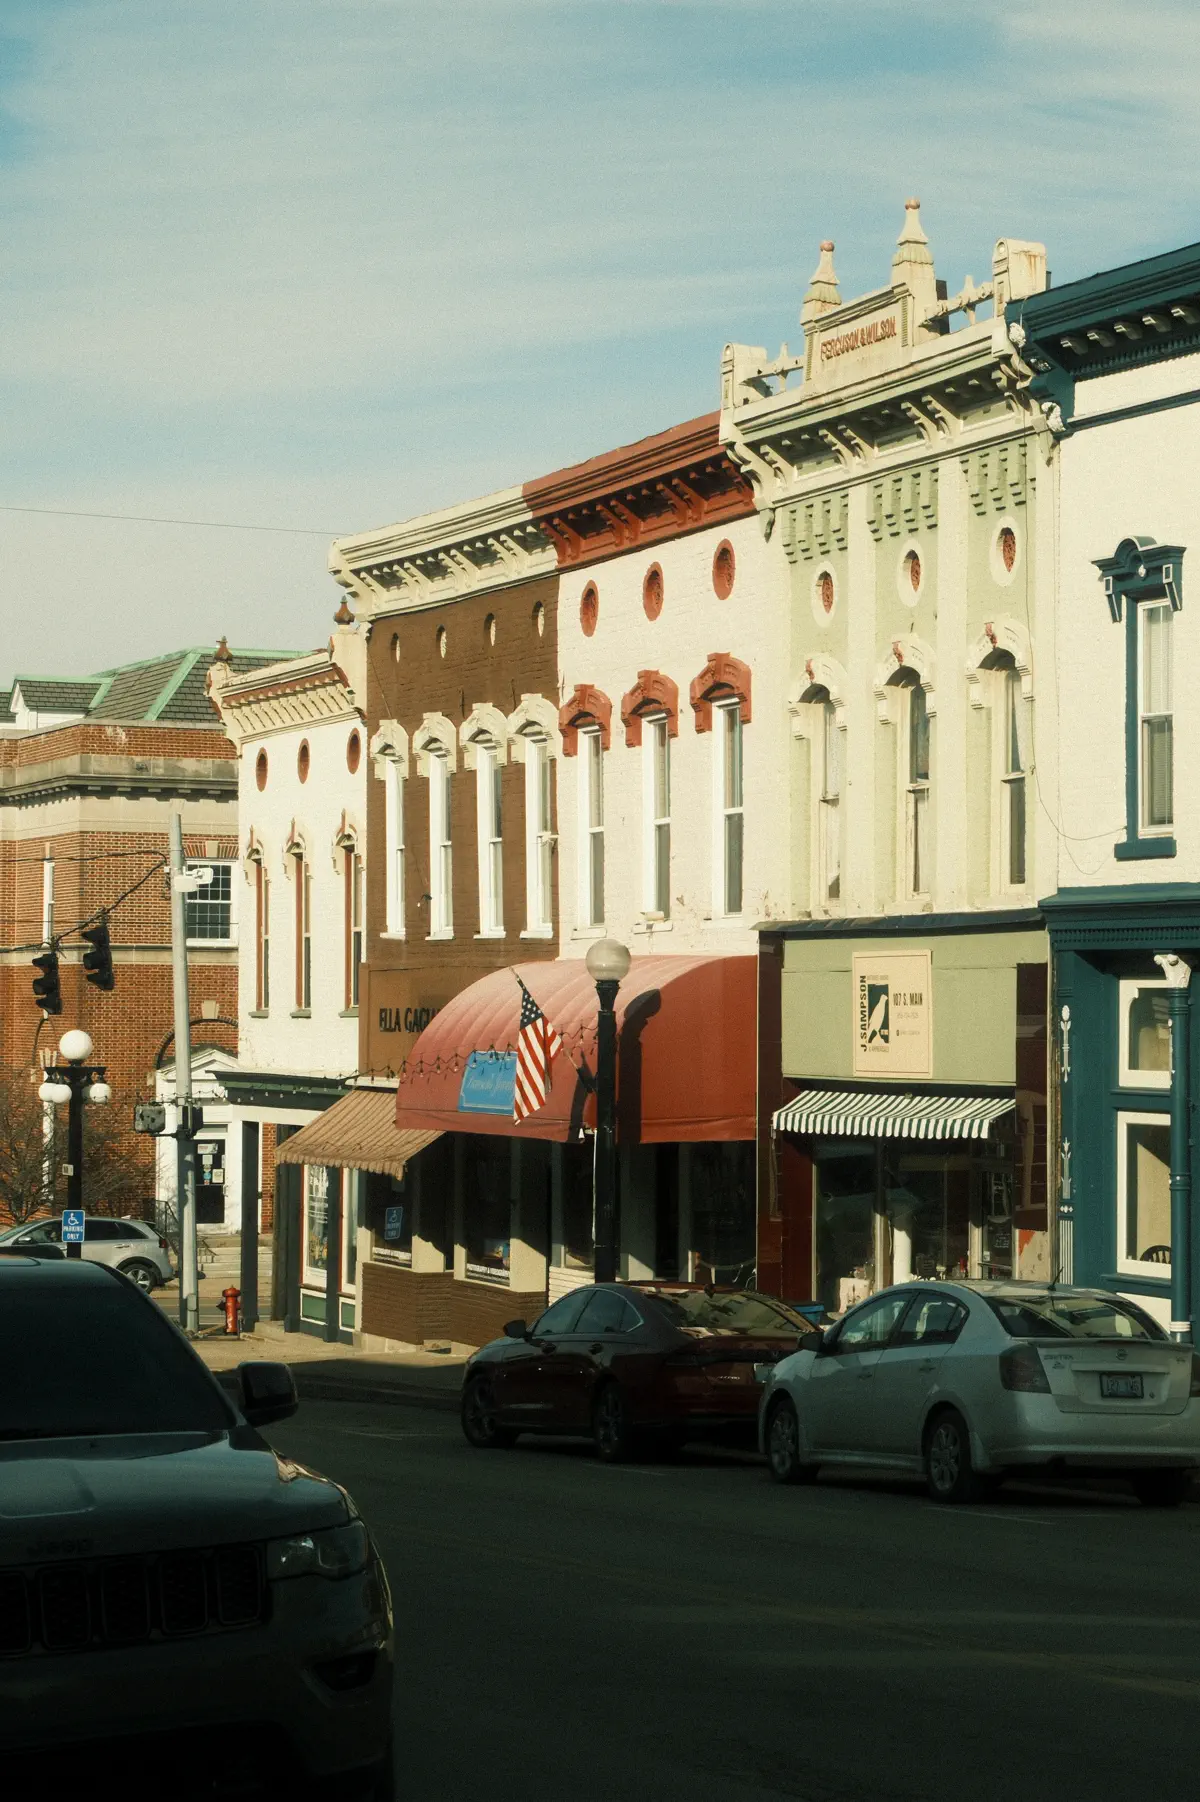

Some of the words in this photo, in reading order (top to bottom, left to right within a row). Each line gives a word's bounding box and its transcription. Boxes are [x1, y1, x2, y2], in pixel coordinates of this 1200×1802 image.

[820, 328, 860, 362] FERGUSON
[860, 327, 866, 347] &
[866, 316, 897, 346] WILSON
[893, 993, 902, 1006] 107
[909, 993, 923, 1006] MAIN
[380, 1007, 401, 1033] ELLA
